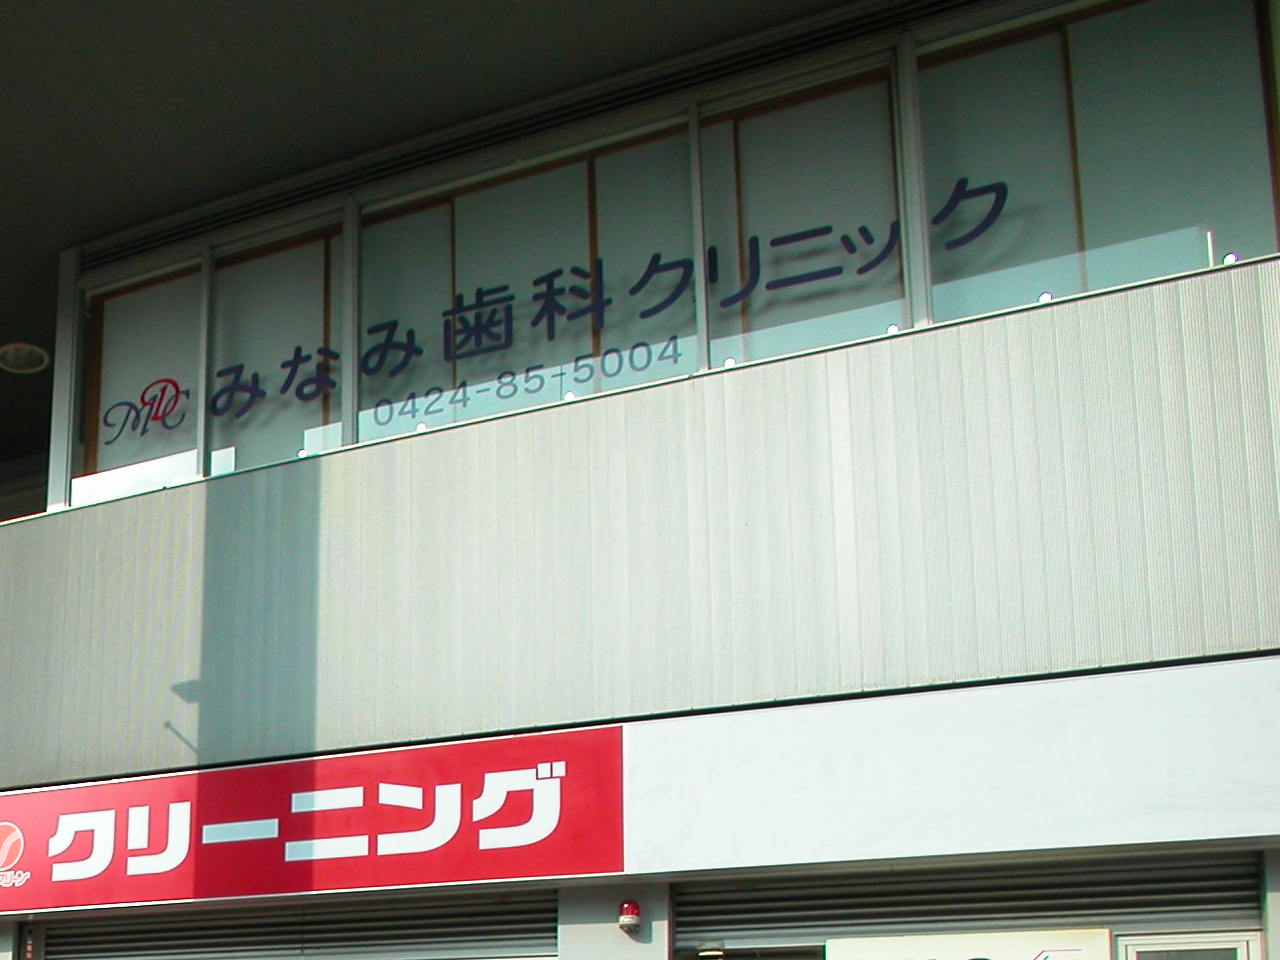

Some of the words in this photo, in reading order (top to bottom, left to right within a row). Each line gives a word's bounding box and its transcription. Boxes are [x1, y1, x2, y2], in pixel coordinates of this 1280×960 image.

[207, 177, 1010, 419] みなみ歯科クリニック
[372, 334, 683, 428] 0424-85-5004
[48, 760, 566, 881] クリーニング
